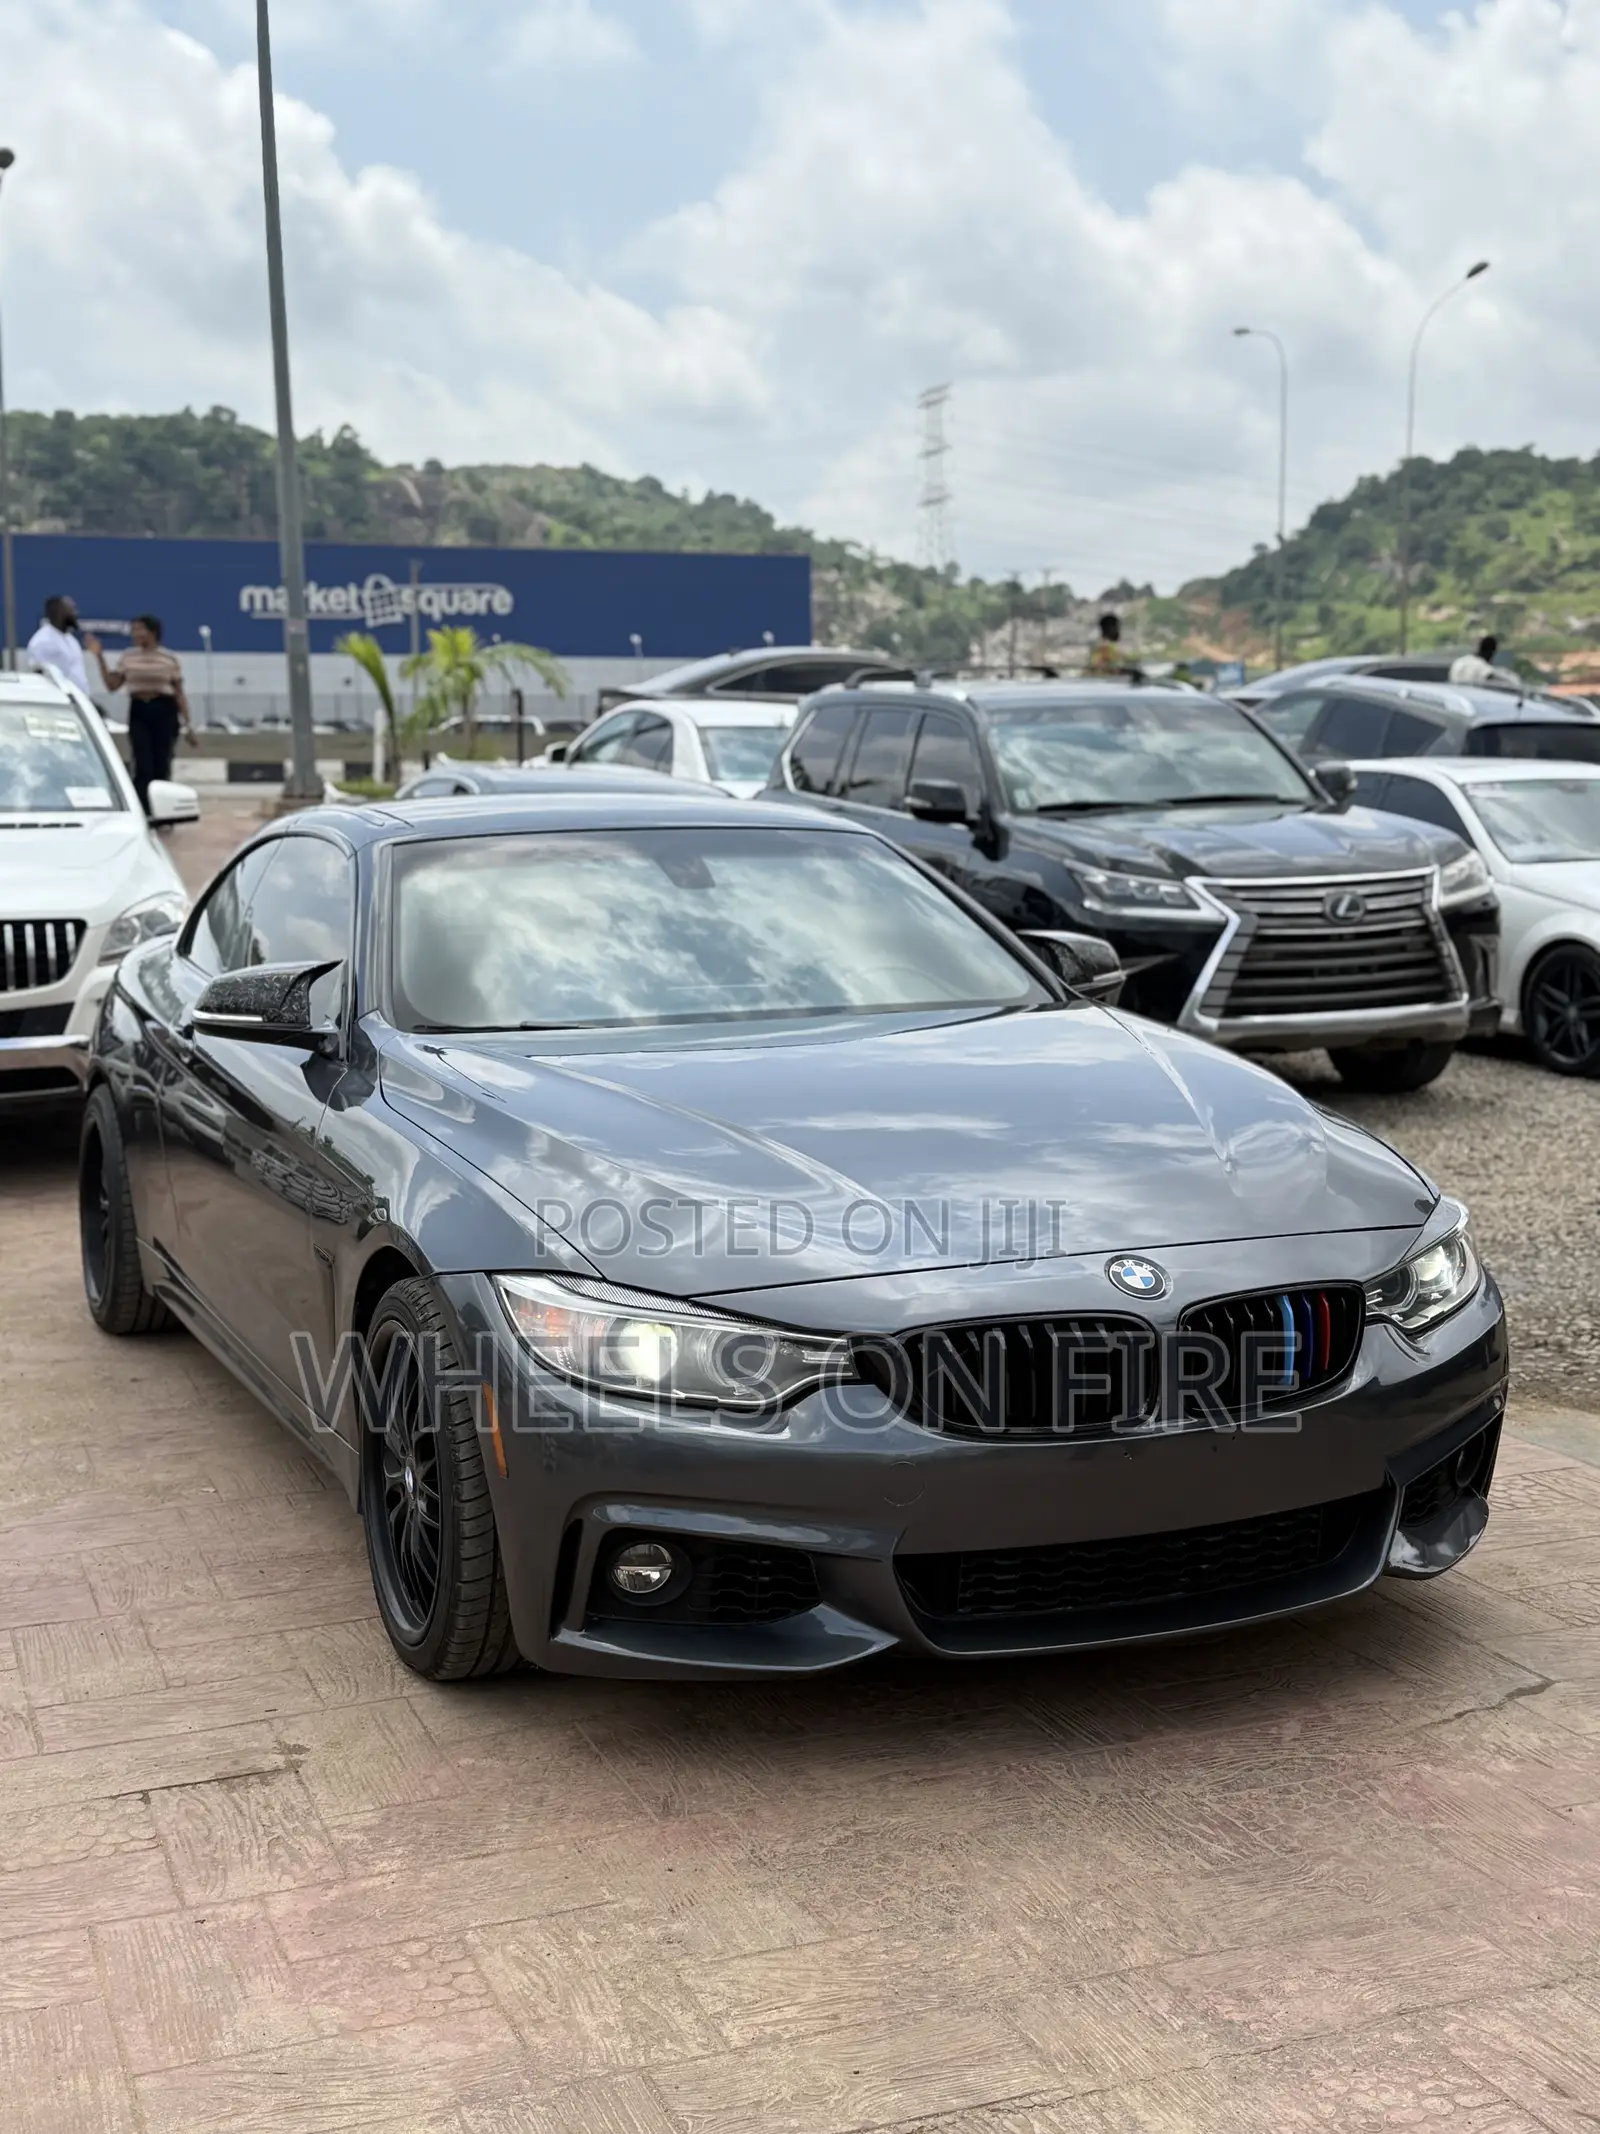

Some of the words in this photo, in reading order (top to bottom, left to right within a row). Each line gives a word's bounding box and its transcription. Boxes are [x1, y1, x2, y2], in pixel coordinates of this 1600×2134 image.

[239, 580, 360, 613] maket
[400, 587, 514, 622] square
[1110, 1259, 1154, 1273] BMW
